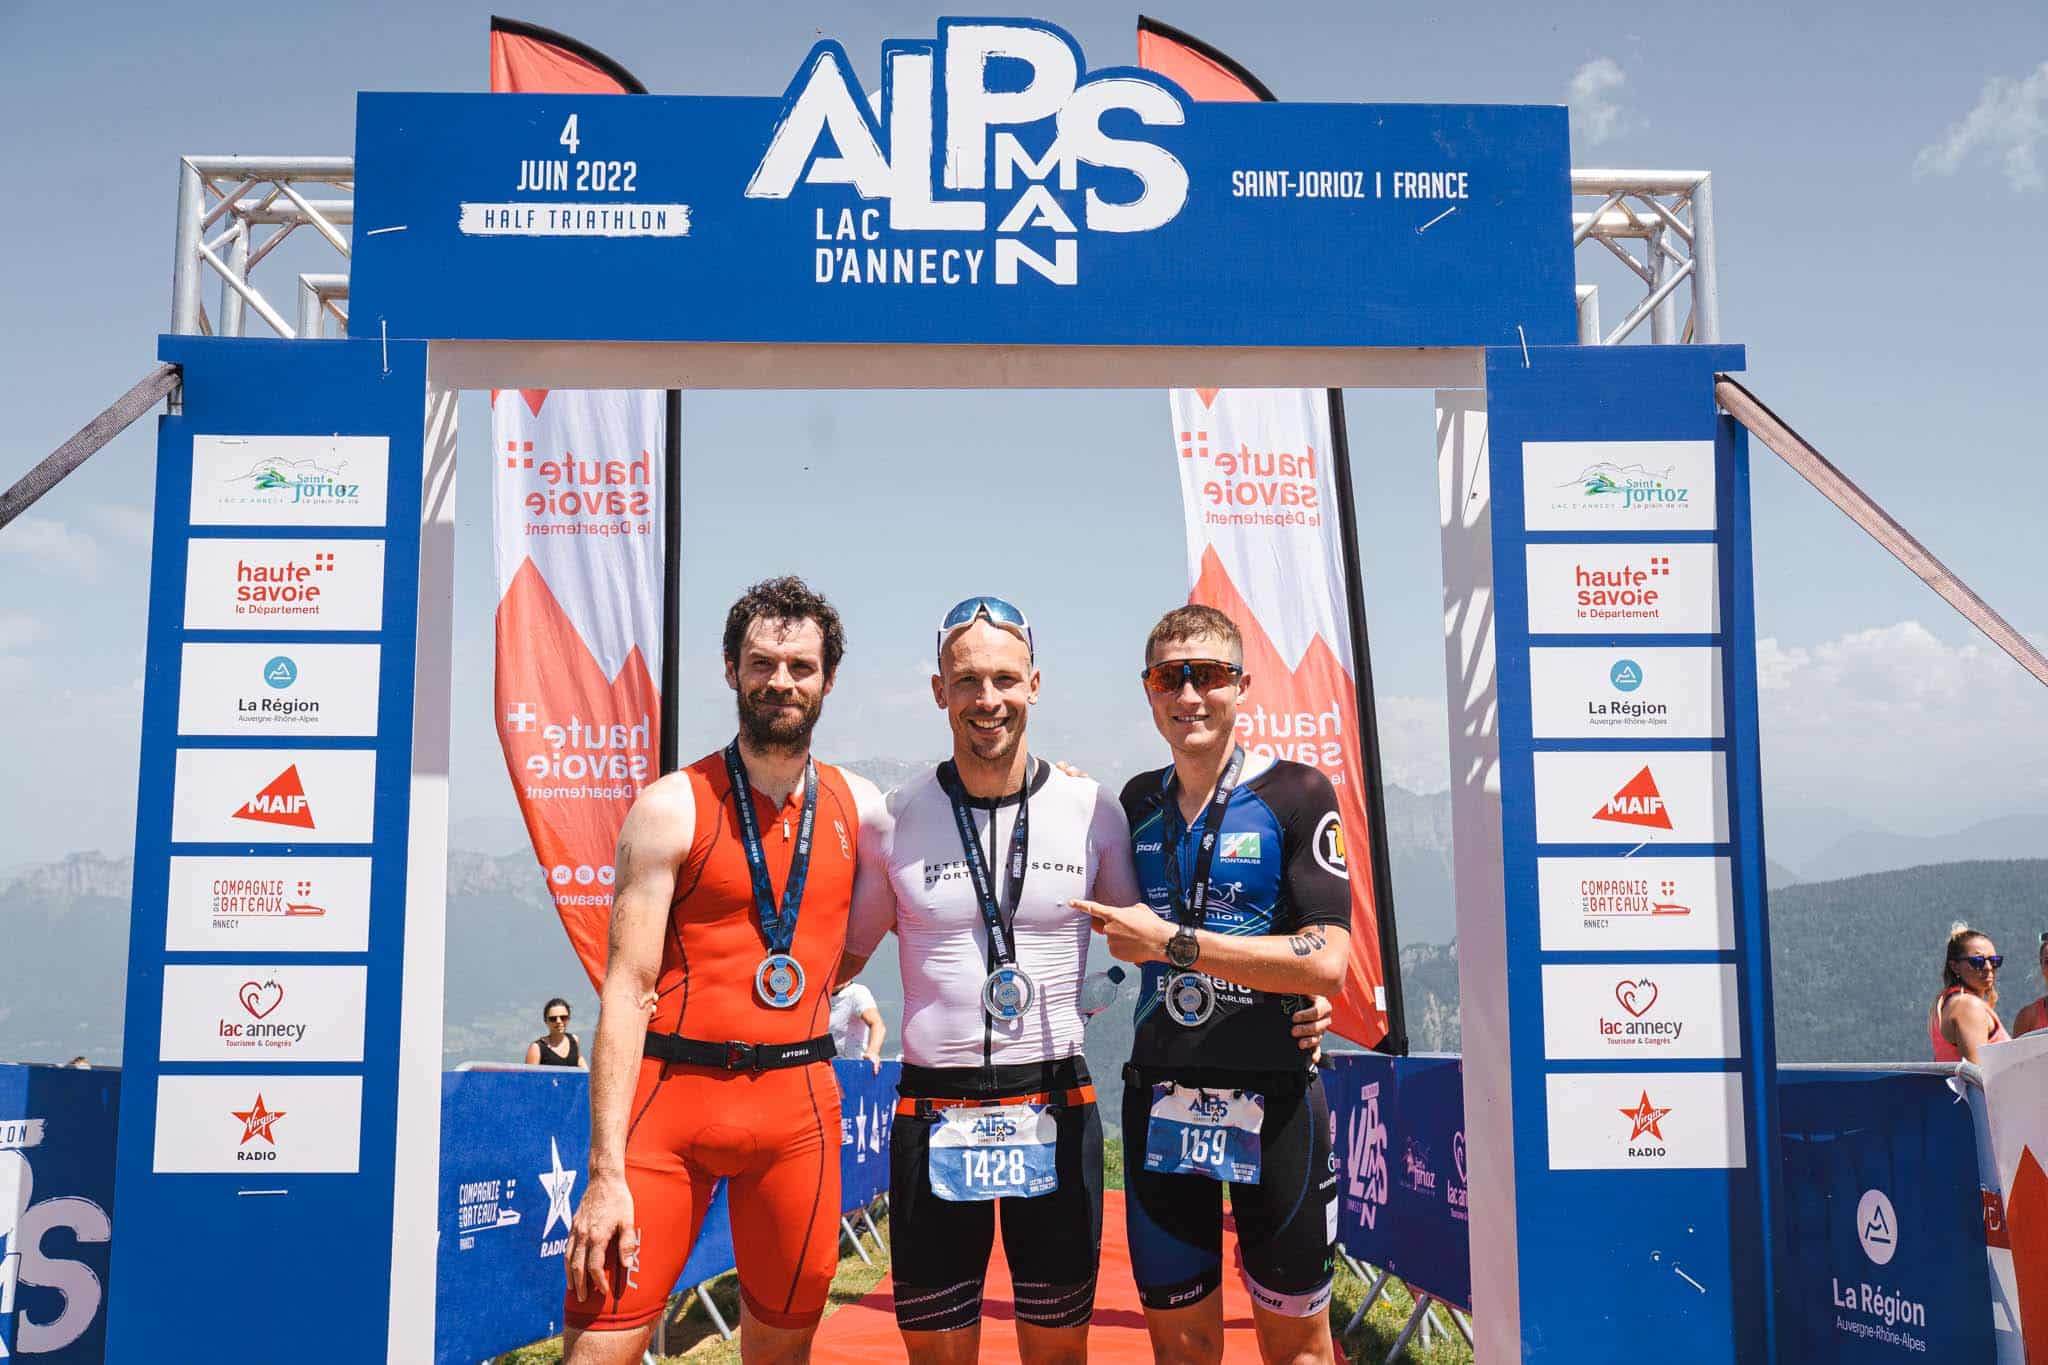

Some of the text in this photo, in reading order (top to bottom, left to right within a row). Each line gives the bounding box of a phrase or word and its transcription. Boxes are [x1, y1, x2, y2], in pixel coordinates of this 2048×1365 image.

[560, 114, 580, 154] 4
[745, 25, 1190, 233] ALPS
[517, 160, 637, 191] JUIN 2022
[1231, 170, 1365, 198] SAINT-JORIOZ
[1393, 172, 1469, 199] FRANCE
[485, 209, 668, 230] HALF TRIATHLON
[816, 208, 880, 241] LAC
[815, 247, 985, 284] D'ANNECY
[296, 473, 325, 484] Saint
[1626, 478, 1654, 488] Saint
[237, 559, 311, 583] haute
[1575, 565, 1648, 588] haute
[237, 584, 321, 602] savoie
[1577, 588, 1659, 606] savoie
[235, 604, 321, 616] le Département
[1577, 608, 1660, 620] le Département
[238, 697, 320, 714] La Région
[1588, 701, 1667, 717] La Région
[248, 795, 307, 814] MAIF
[1607, 796, 1663, 815] MAIF
[833, 819, 850, 860] 2XU
[213, 880, 284, 896] COMPAGNIE
[1581, 880, 1649, 896] COMPAGNIE
[221, 896, 283, 913] BATEAUX
[1590, 896, 1649, 912] BATEAUX
[212, 919, 239, 929] ANNECY
[1584, 919, 1609, 929] ANNECY
[219, 1018, 306, 1042] lac annecy
[1600, 1015, 1683, 1040] lac annecy
[237, 1151, 277, 1161] RADIO
[1628, 1148, 1666, 1157] RADIO
[962, 1149, 1026, 1187] 1428
[459, 1180, 501, 1204] COMPAGNIE
[1169, 1284, 1204, 1305] poli
[1832, 1277, 1926, 1327] La Région
[1836, 1315, 1927, 1352] Auvergne-Rhône-Alpes
